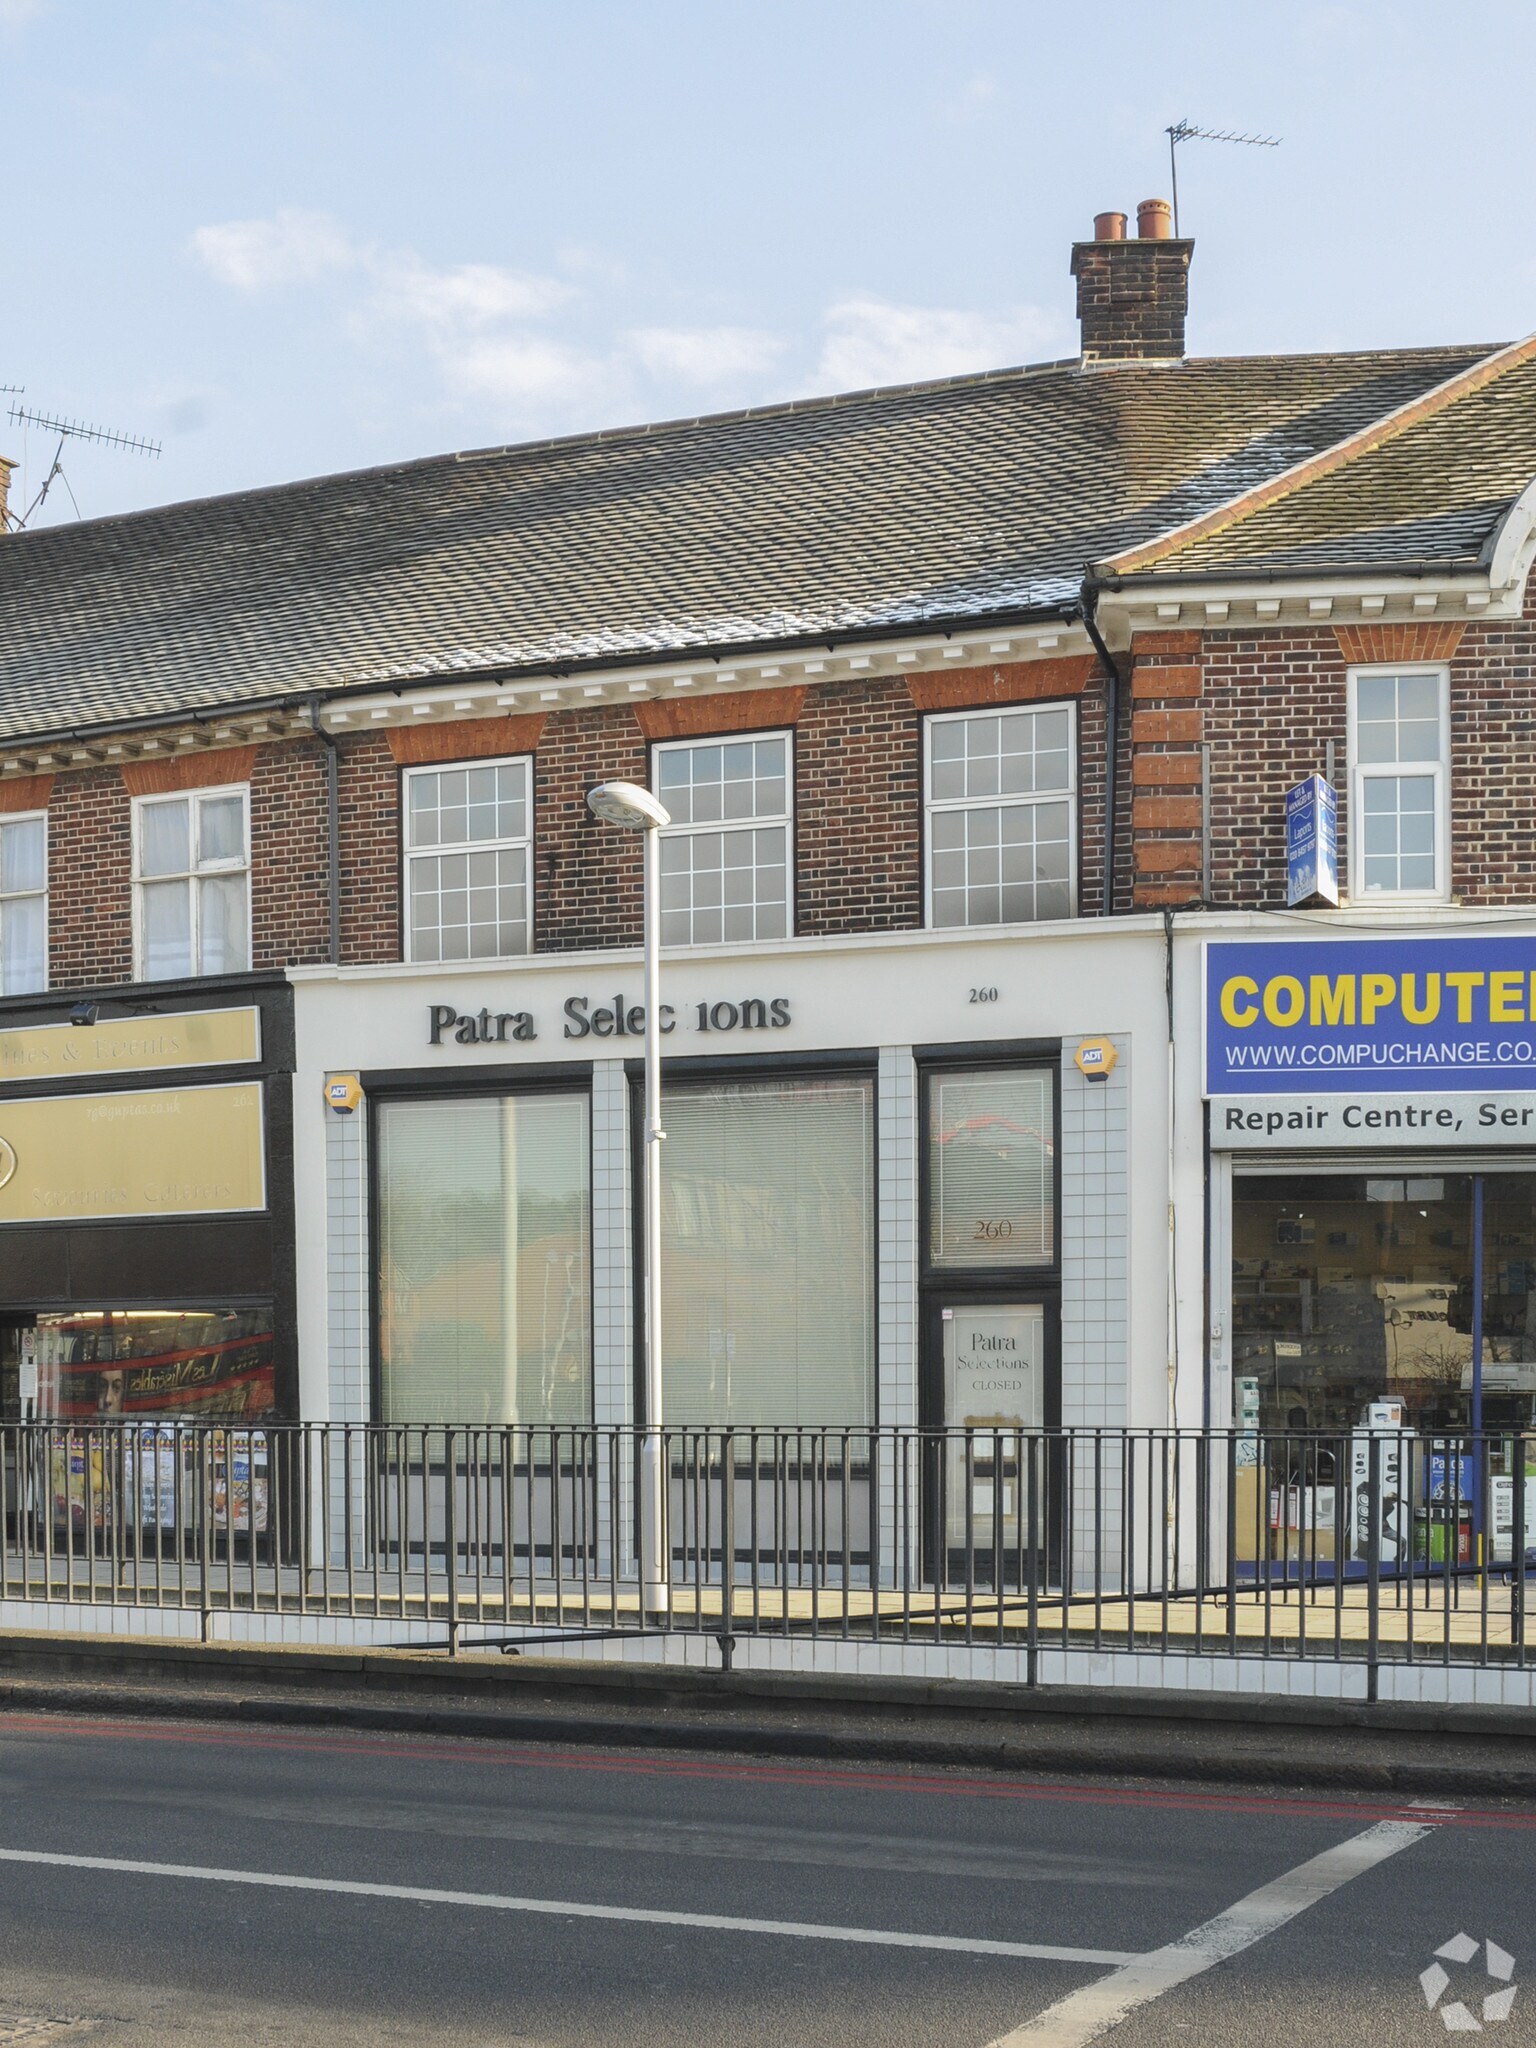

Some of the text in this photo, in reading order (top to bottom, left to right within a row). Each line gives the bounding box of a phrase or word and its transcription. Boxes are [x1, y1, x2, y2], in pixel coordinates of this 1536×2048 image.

[969, 987, 998, 1003] 260
[1220, 971, 1536, 1028] COMPUTE
[427, 1004, 537, 1044] Patra
[62, 1041, 79, 1062] &
[1083, 1049, 1103, 1062] ADT
[331, 1086, 347, 1097] ADT
[233, 1096, 254, 1107] 262
[1226, 1103, 1533, 1135] Repair Centre, Ser
[974, 1220, 1012, 1240] 260
[972, 1333, 1016, 1351] Patra
[957, 1356, 1030, 1370] Selections
[972, 1380, 1021, 1391] CLOSED
